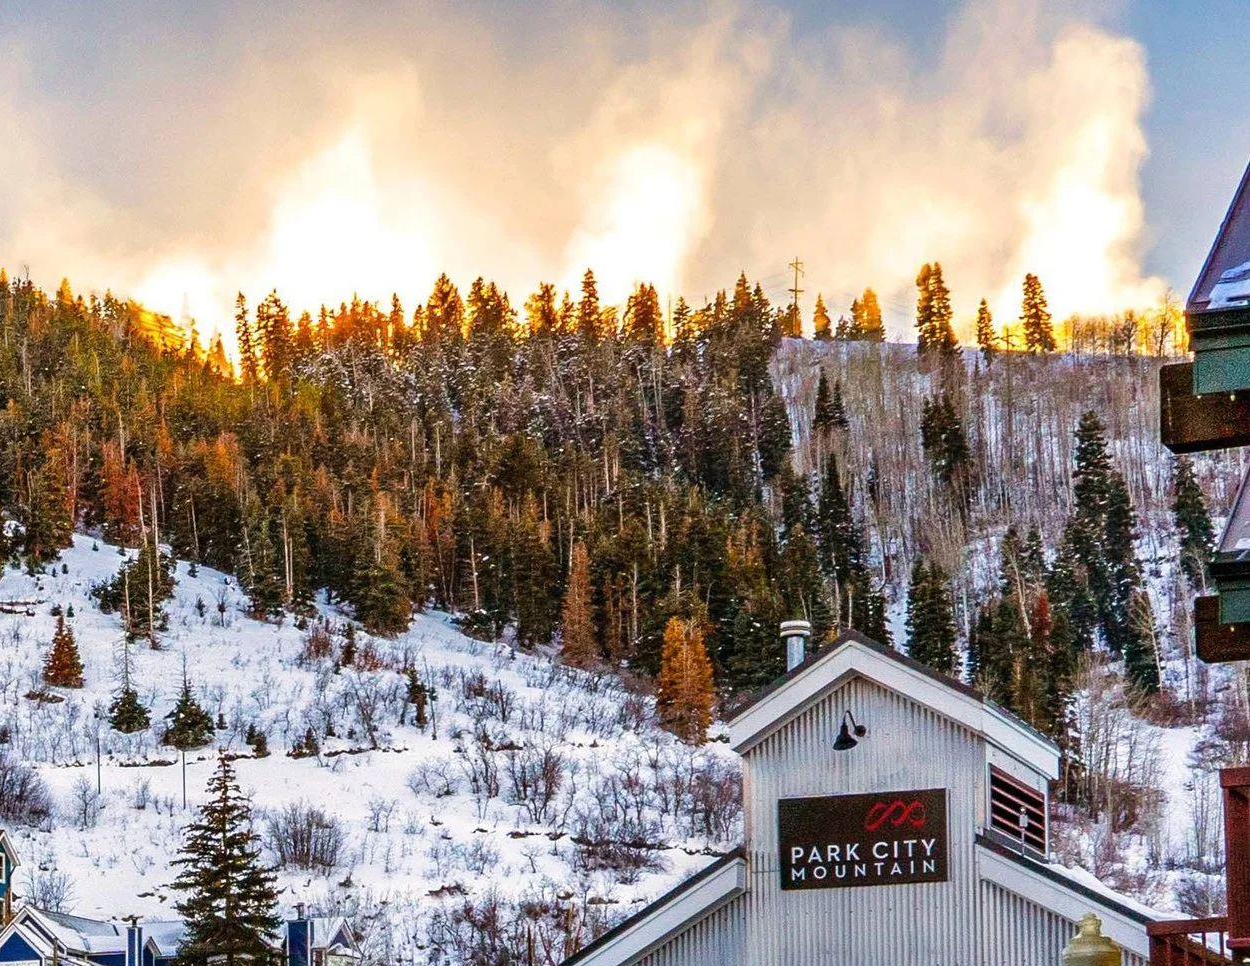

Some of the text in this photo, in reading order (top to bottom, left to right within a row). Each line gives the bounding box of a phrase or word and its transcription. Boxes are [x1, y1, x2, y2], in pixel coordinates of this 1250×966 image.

[791, 838, 936, 865] PARK CITY
[791, 859, 935, 881] MOUNTAIN
